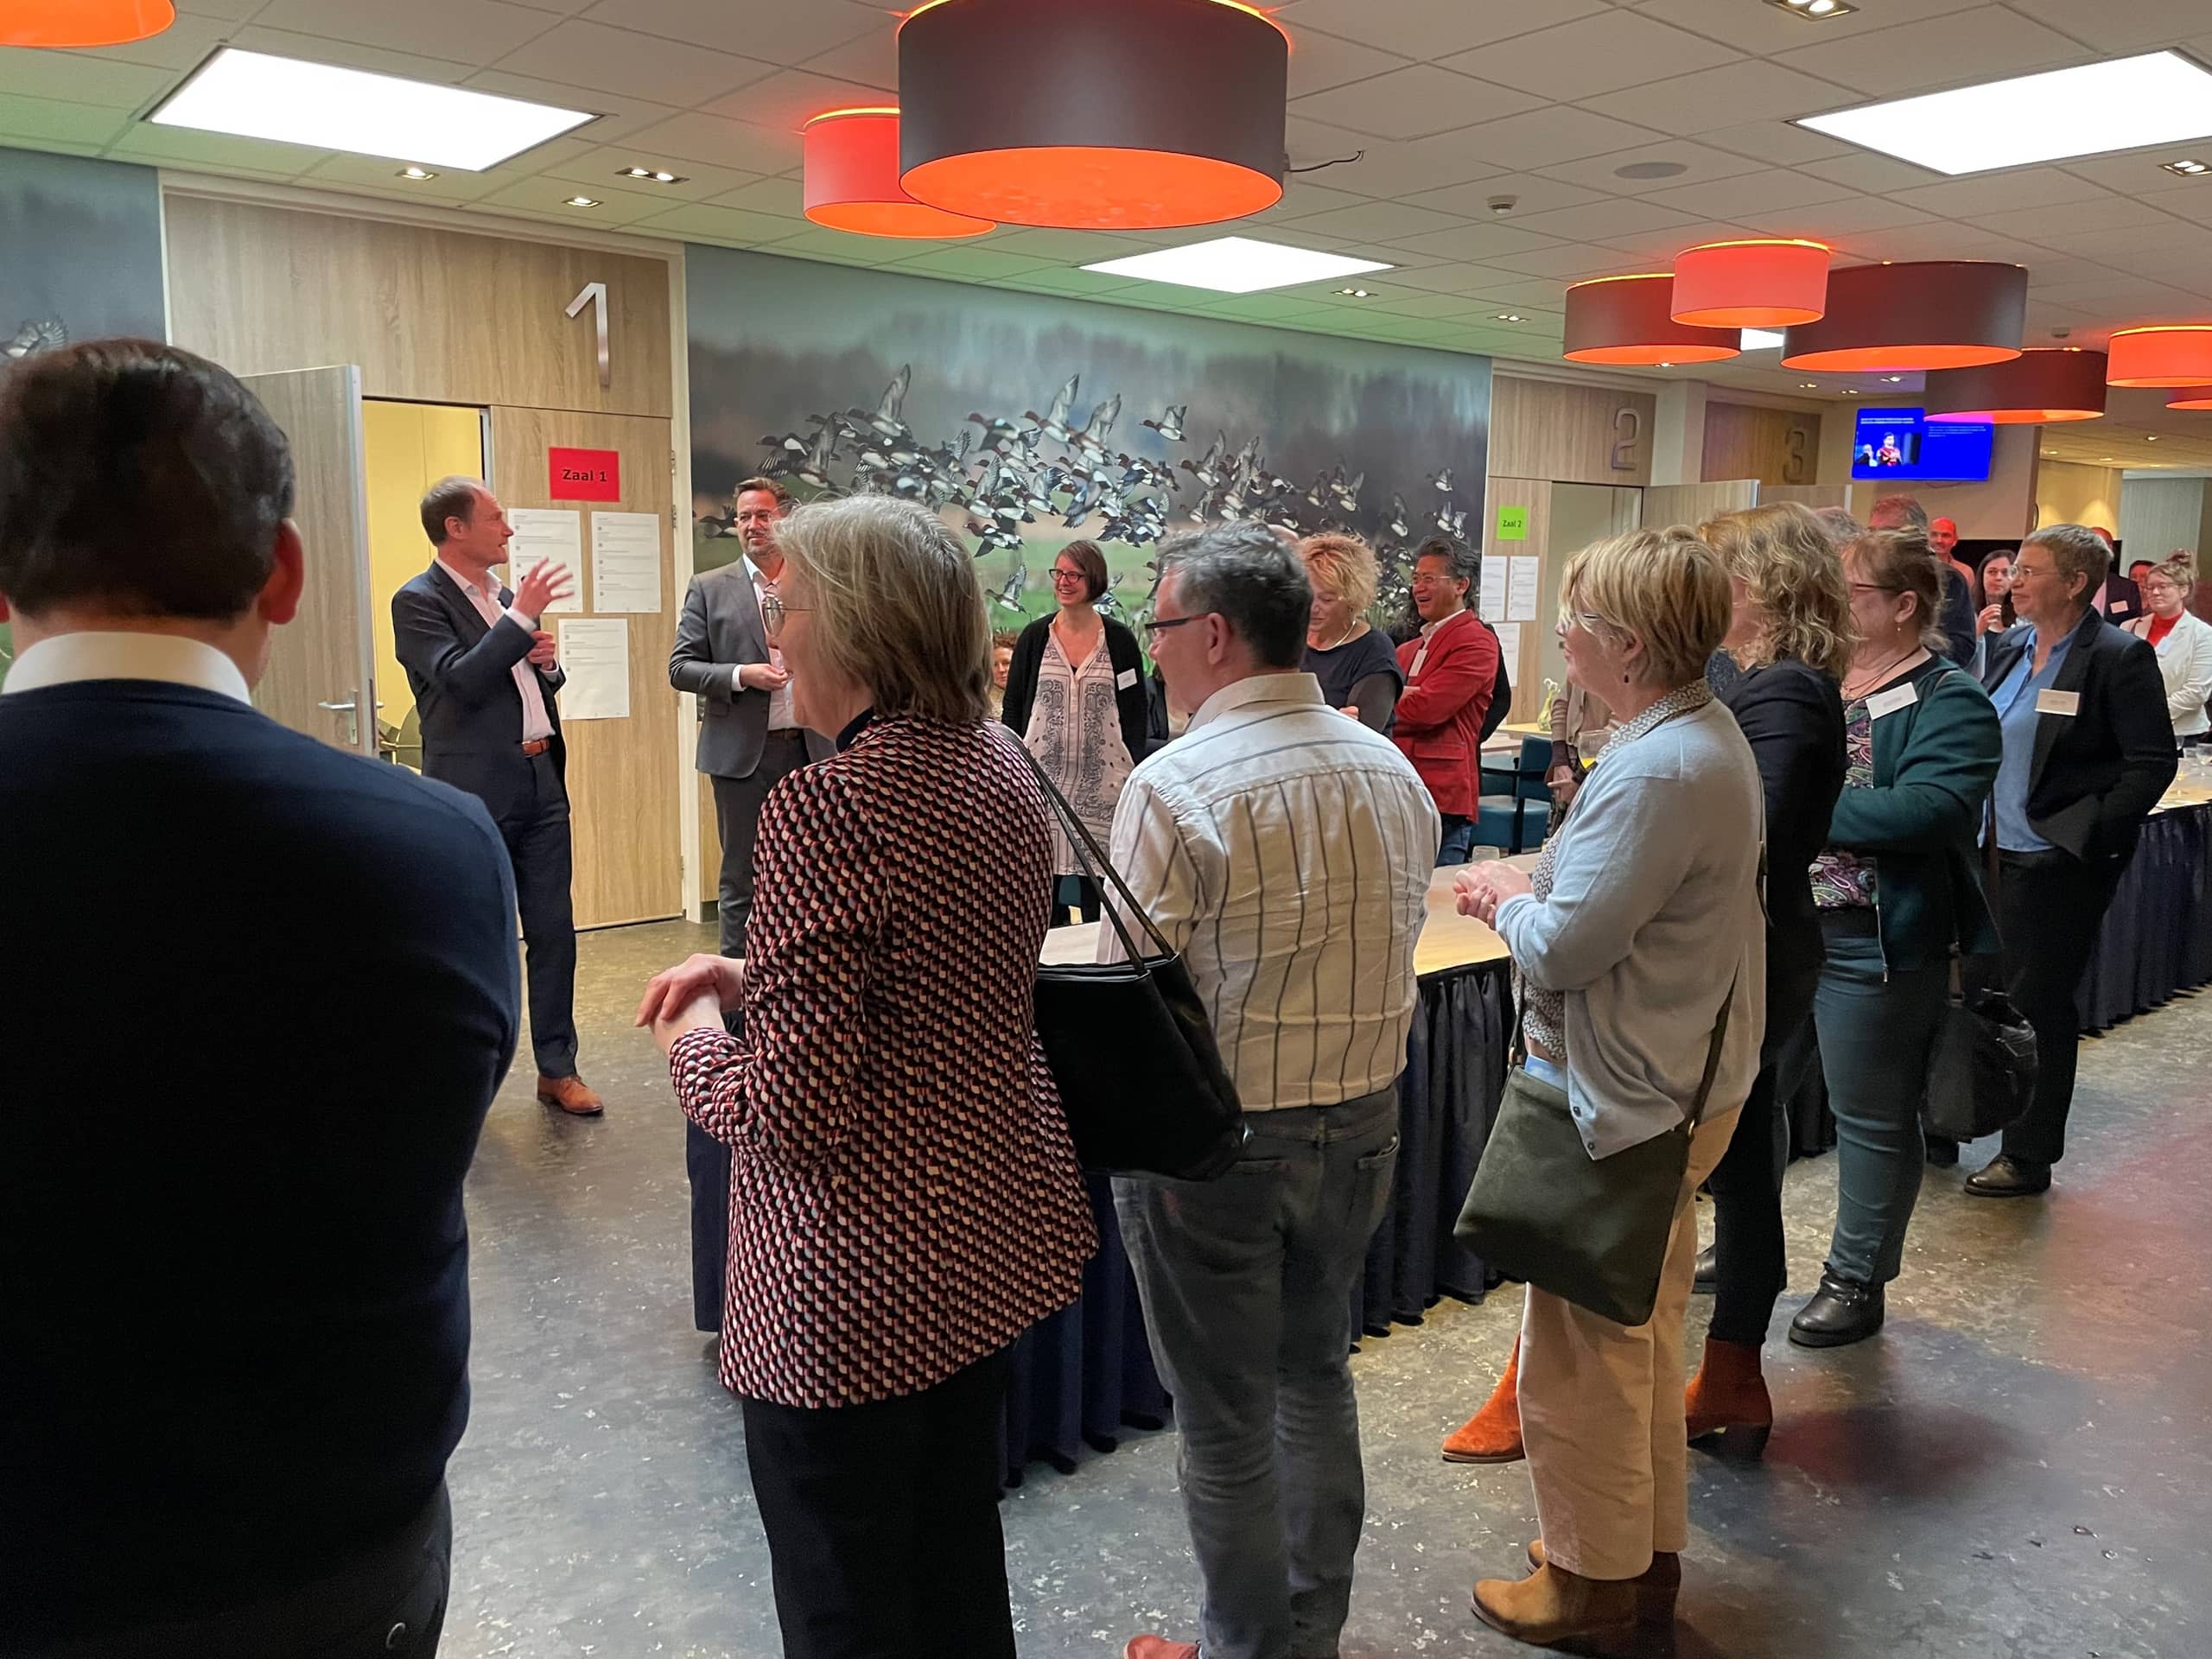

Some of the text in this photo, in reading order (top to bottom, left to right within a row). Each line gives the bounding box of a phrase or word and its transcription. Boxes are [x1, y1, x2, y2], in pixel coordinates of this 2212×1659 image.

[565, 282, 608, 388] 1
[1611, 407, 1641, 471] 2
[1783, 428, 1807, 483] 3
[563, 469, 607, 482] Zaal 1
[1503, 519, 1516, 528] Zaal
